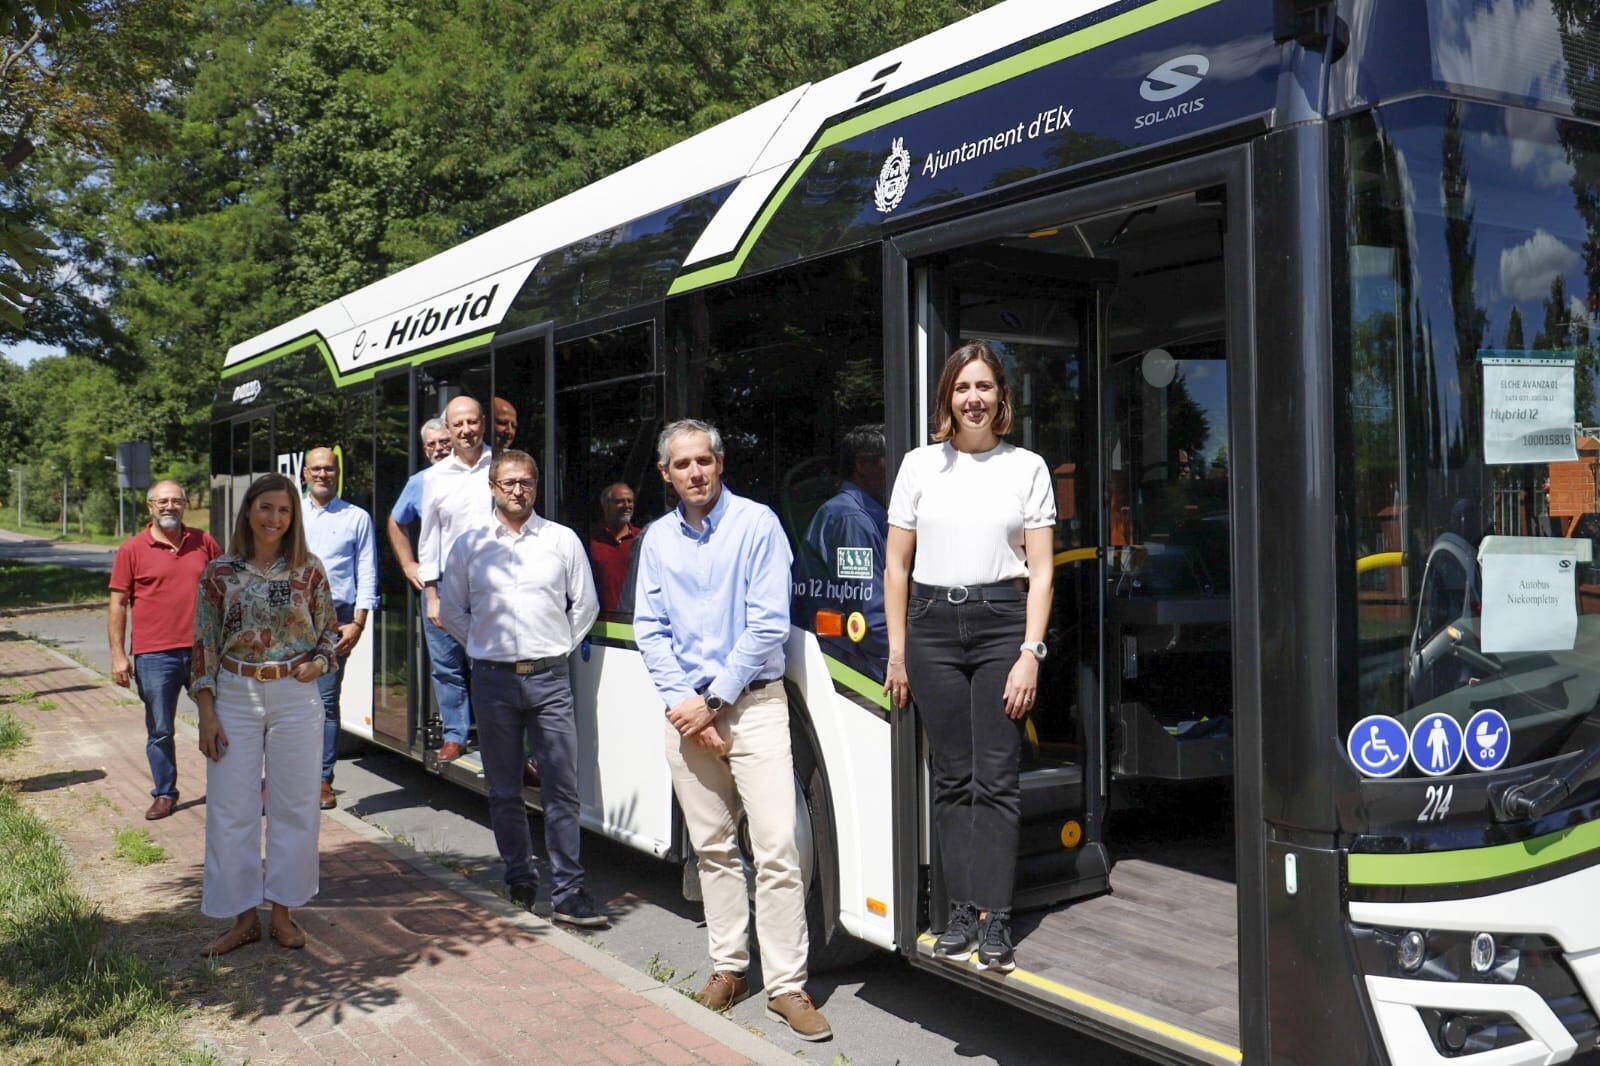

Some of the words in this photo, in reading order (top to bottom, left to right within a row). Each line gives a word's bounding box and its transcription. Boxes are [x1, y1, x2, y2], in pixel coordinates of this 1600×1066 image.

[1134, 97, 1205, 129] SOLARIS
[921, 122, 1025, 178] Ajuntament
[384, 283, 500, 350] Híbrid
[1500, 380, 1520, 389] ELCHE
[1522, 380, 1550, 389] AVANZA
[1490, 408, 1527, 422] Hybrid
[1529, 408, 1539, 420] 12
[1523, 434, 1571, 446] 100015819
[809, 578, 823, 597] 12
[826, 579, 873, 603] hybrid
[1519, 579, 1550, 590] Autobus
[1507, 593, 1559, 607] Niekompletny
[1417, 784, 1454, 821] 214
